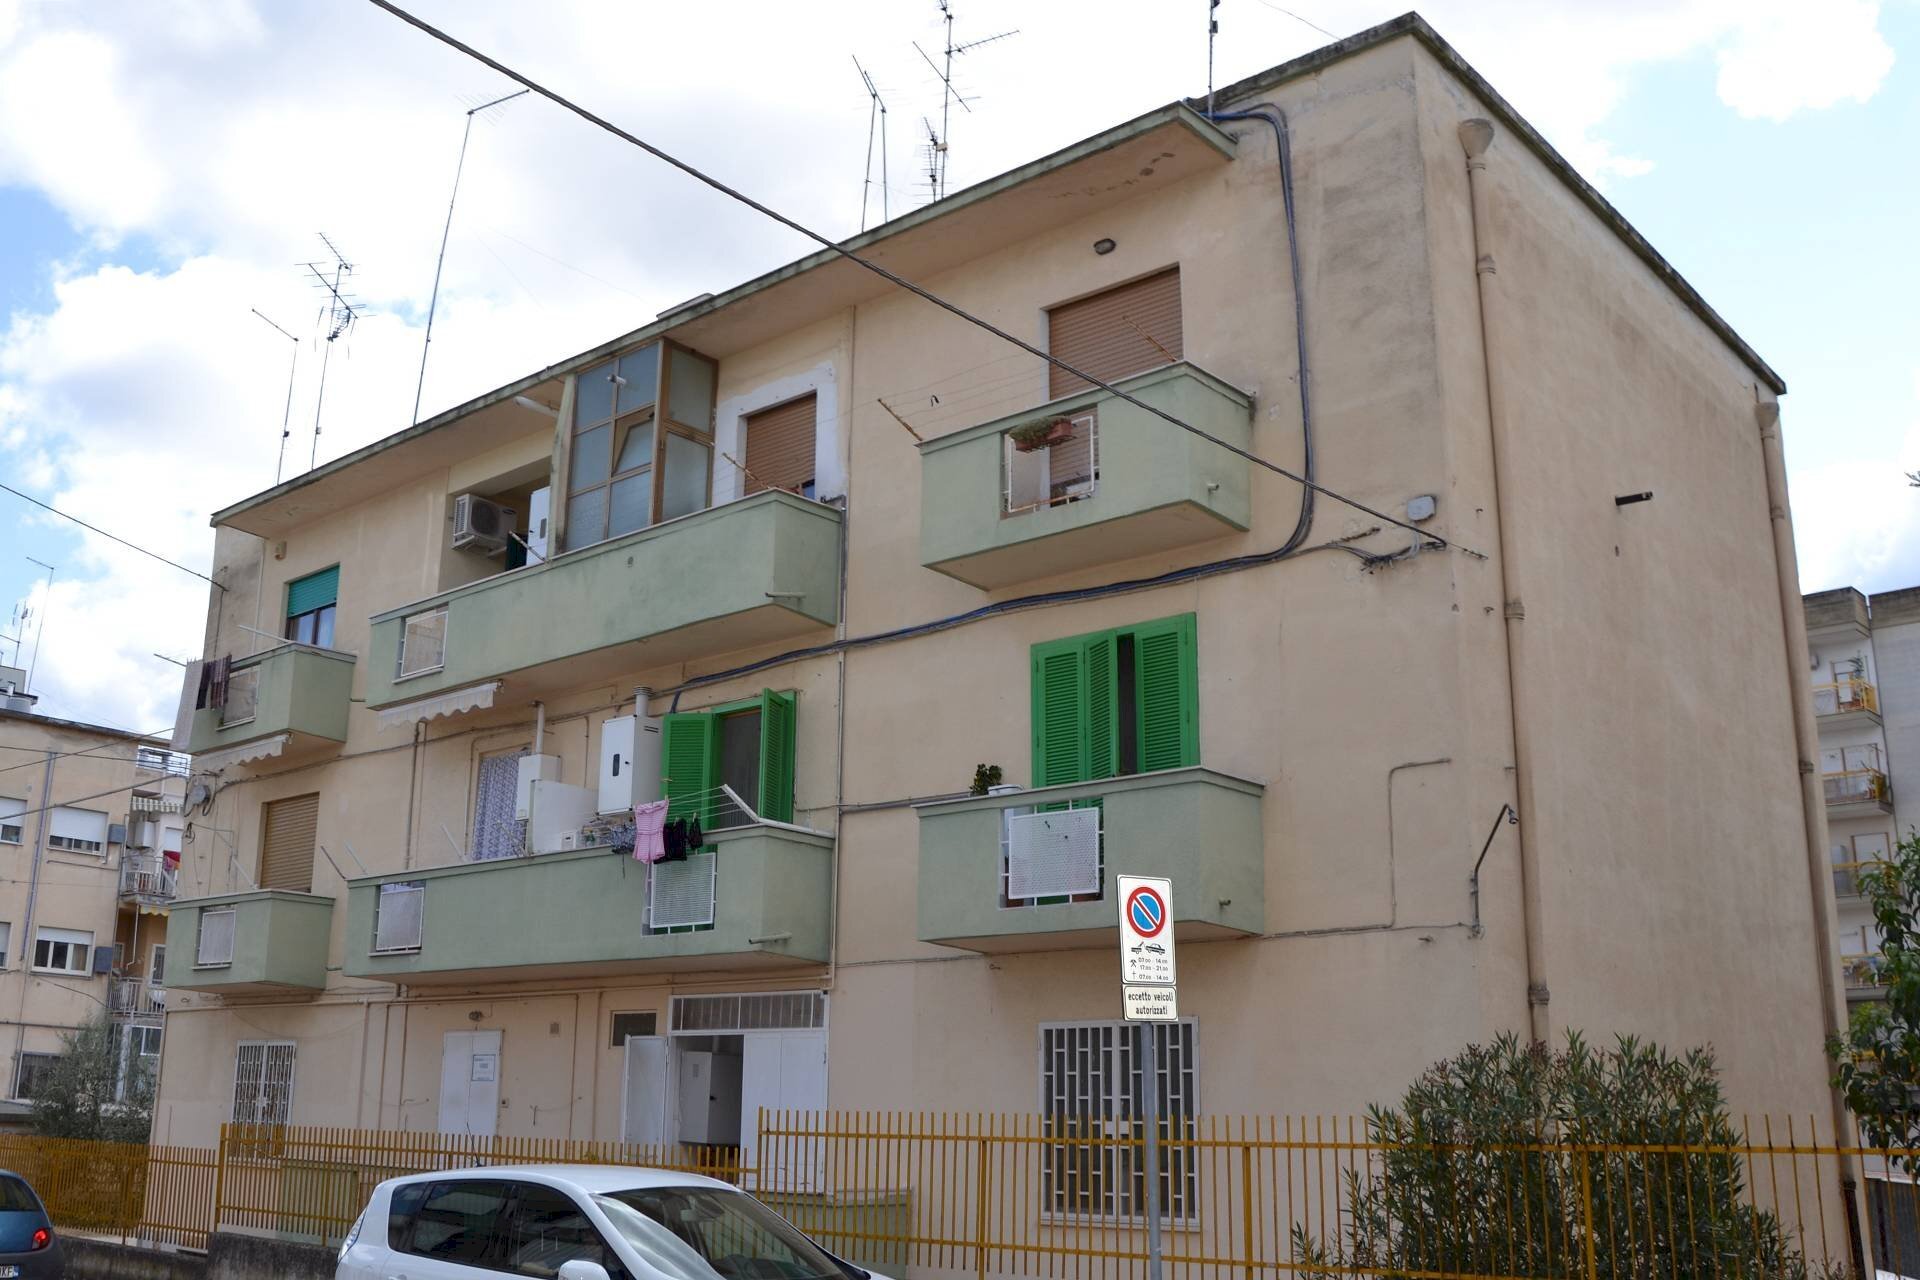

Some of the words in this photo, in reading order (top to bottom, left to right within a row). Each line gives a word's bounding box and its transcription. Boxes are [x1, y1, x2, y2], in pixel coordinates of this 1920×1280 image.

[1128, 992, 1151, 1001] eccetto
[1153, 992, 1173, 1001] veicoli
[1135, 1006, 1167, 1014] autorizzati
